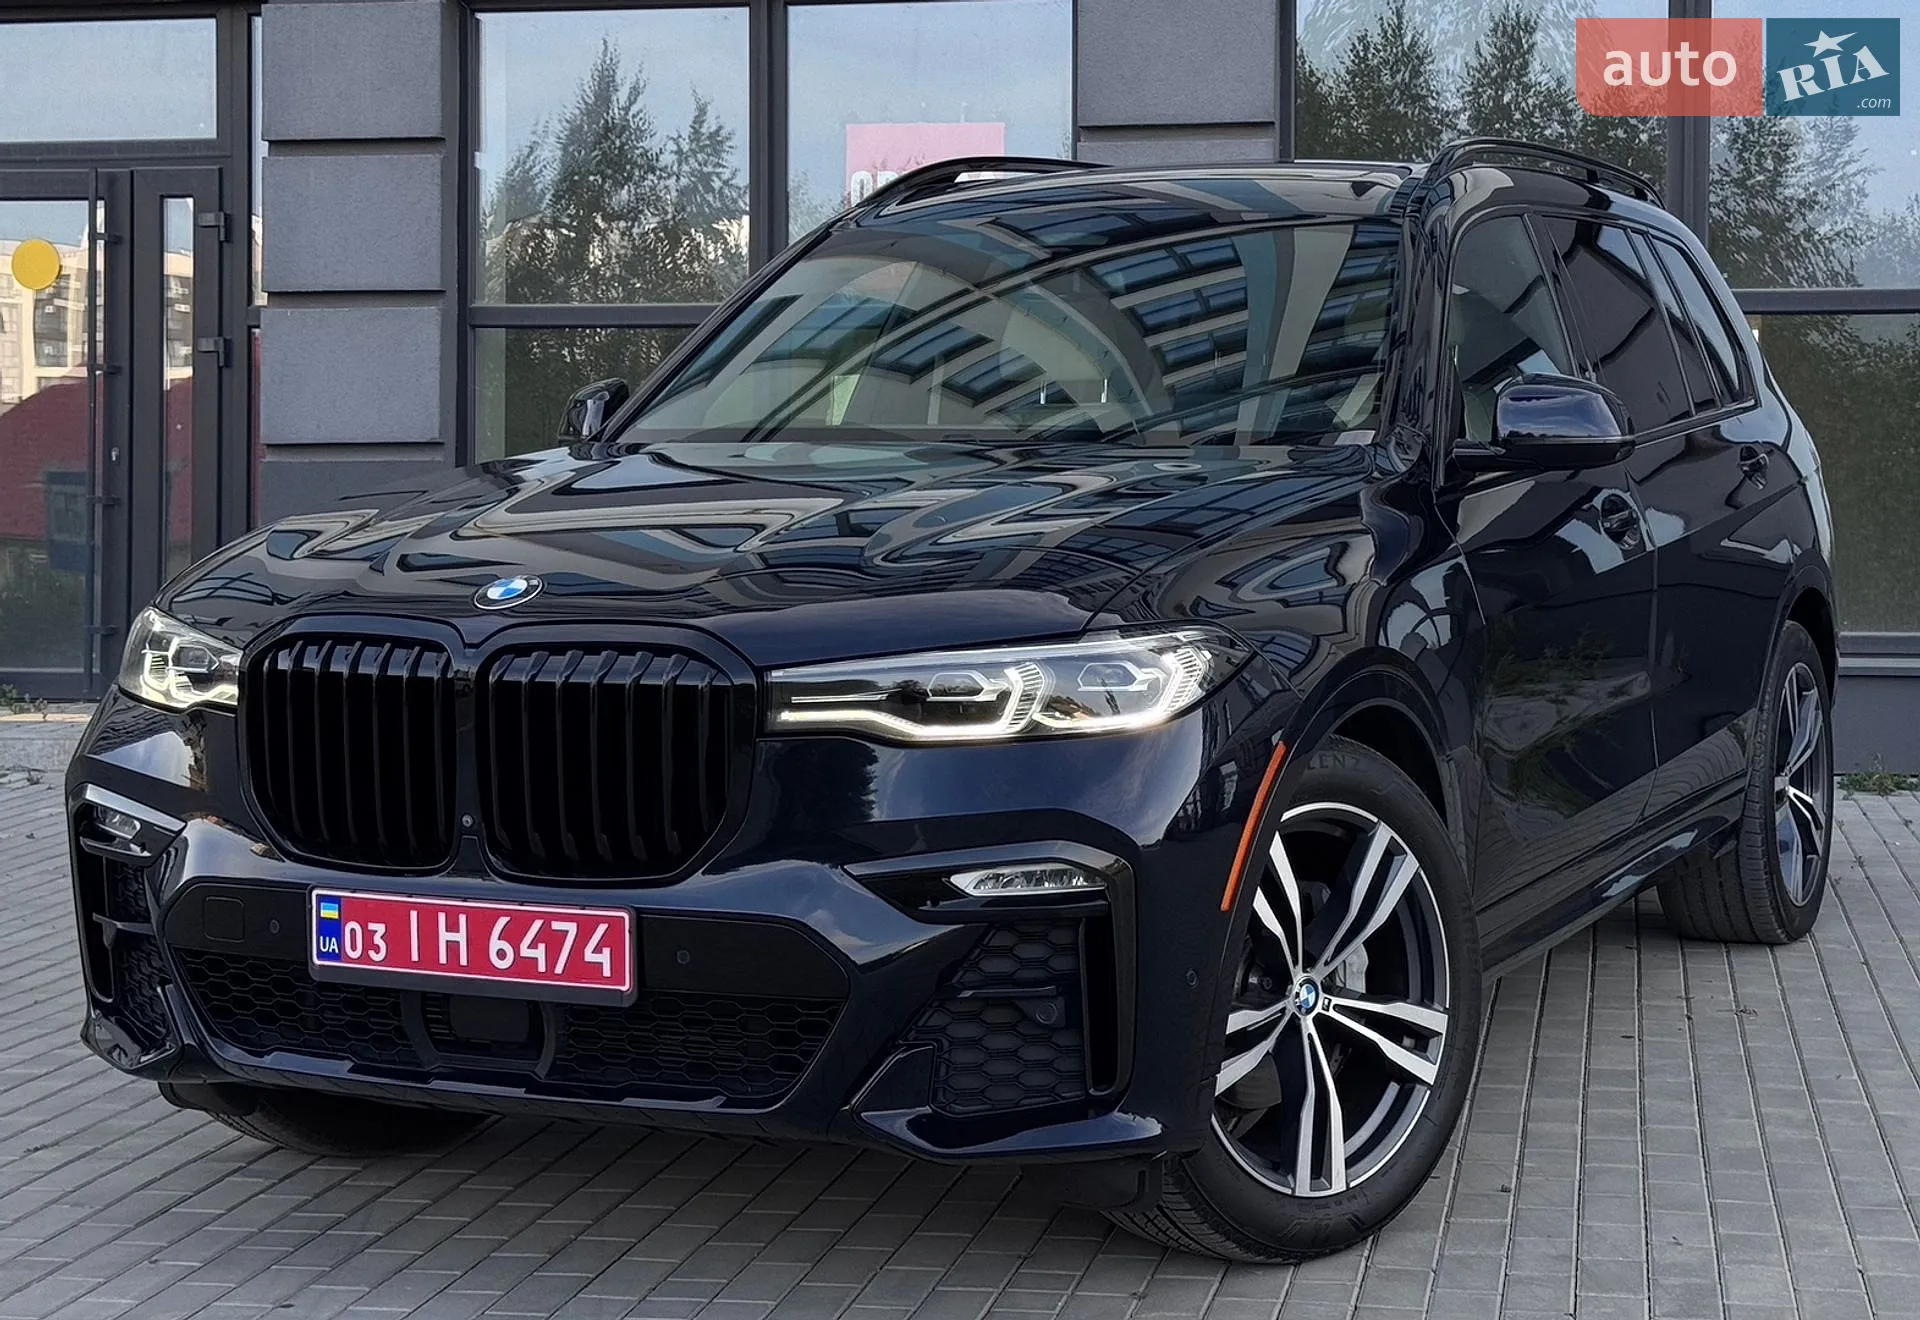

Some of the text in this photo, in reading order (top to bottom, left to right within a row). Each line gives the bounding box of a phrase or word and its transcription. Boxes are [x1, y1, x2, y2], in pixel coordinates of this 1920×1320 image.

[320, 935, 339, 953] UA
[344, 921, 387, 962] 03
[488, 916, 611, 977] 6474
